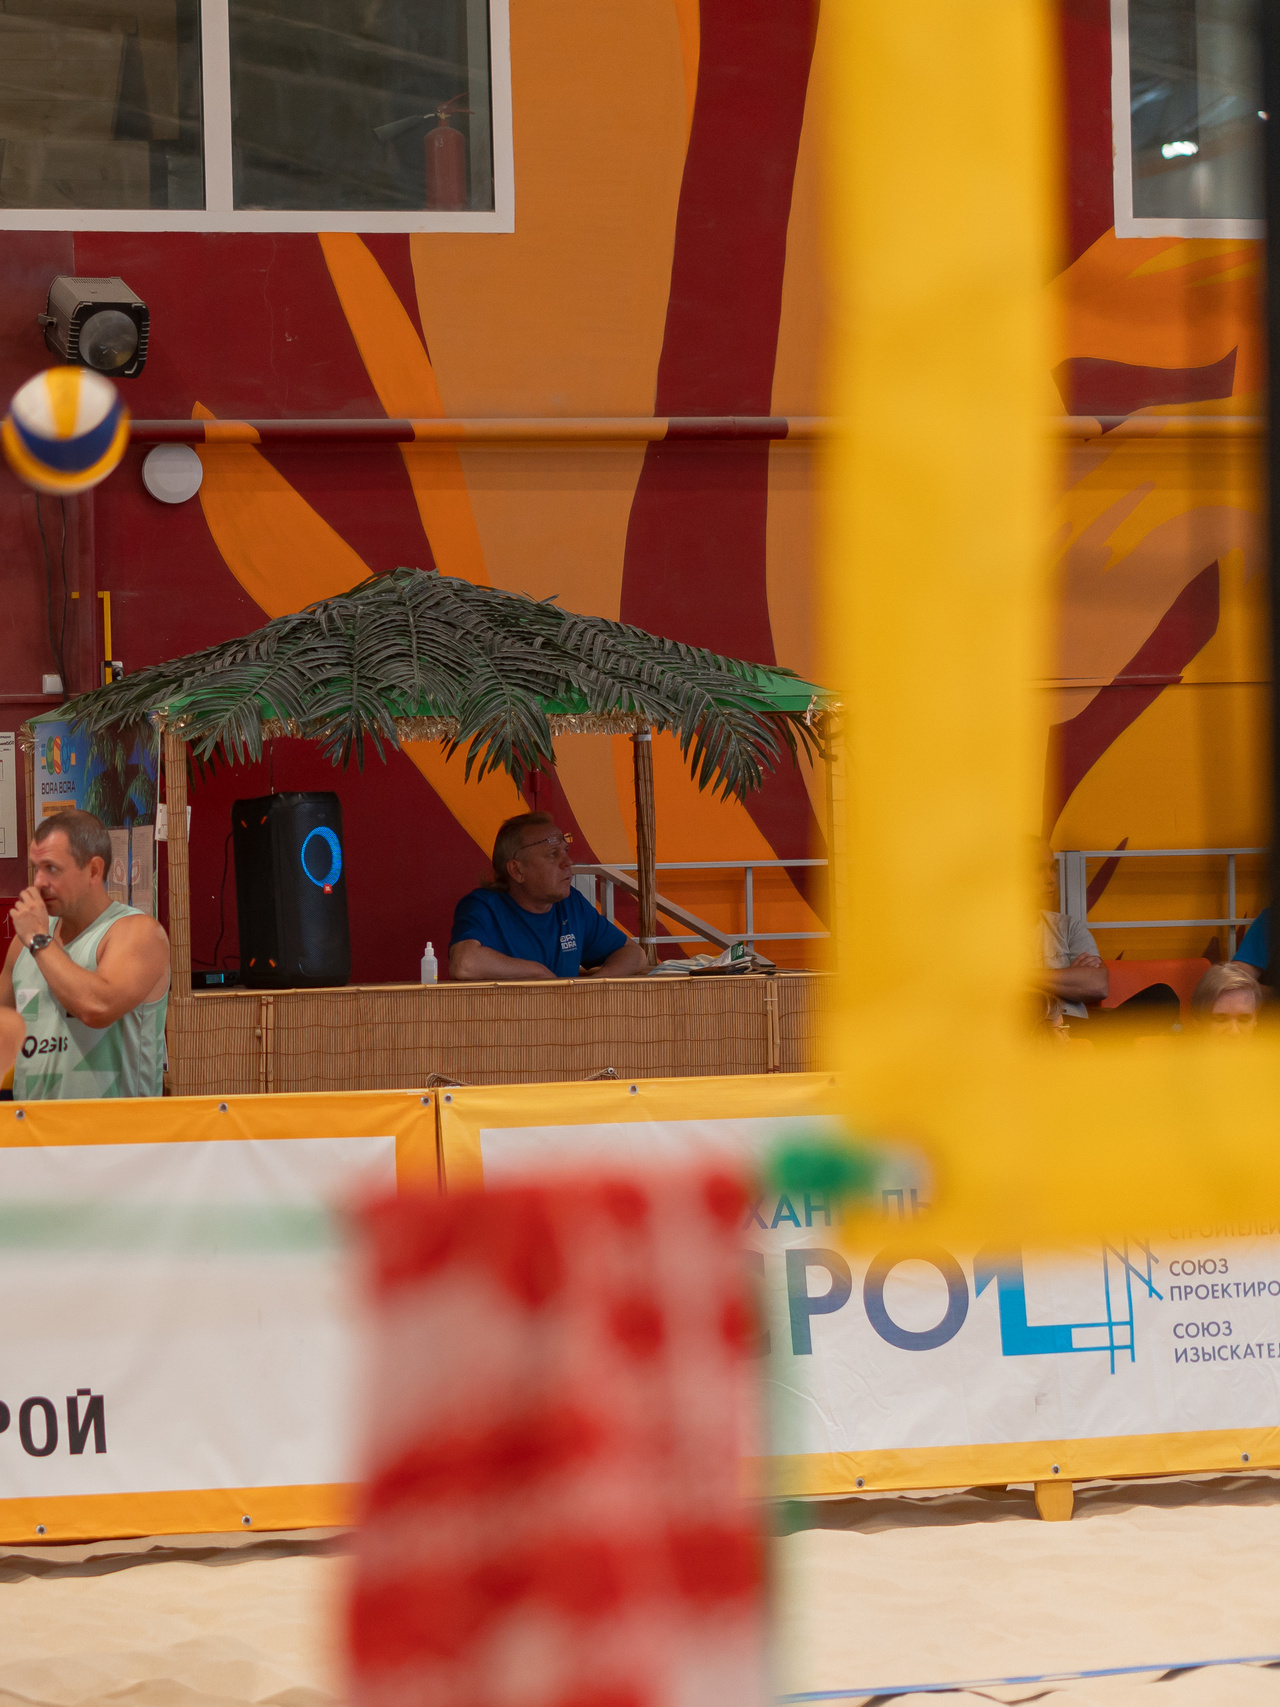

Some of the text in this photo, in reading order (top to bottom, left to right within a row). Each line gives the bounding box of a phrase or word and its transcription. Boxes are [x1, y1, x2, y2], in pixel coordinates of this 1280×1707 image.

[42, 781, 76, 795] BORA BORA
[1169, 1258, 1229, 1277] СОЮЗ
[1170, 1280, 1280, 1301] ПРОЕКТИРО
[734, 1247, 969, 1356] РО
[1173, 1320, 1233, 1339] СОЮЗ
[1174, 1343, 1280, 1363] ИЗЫСКАТЕ
